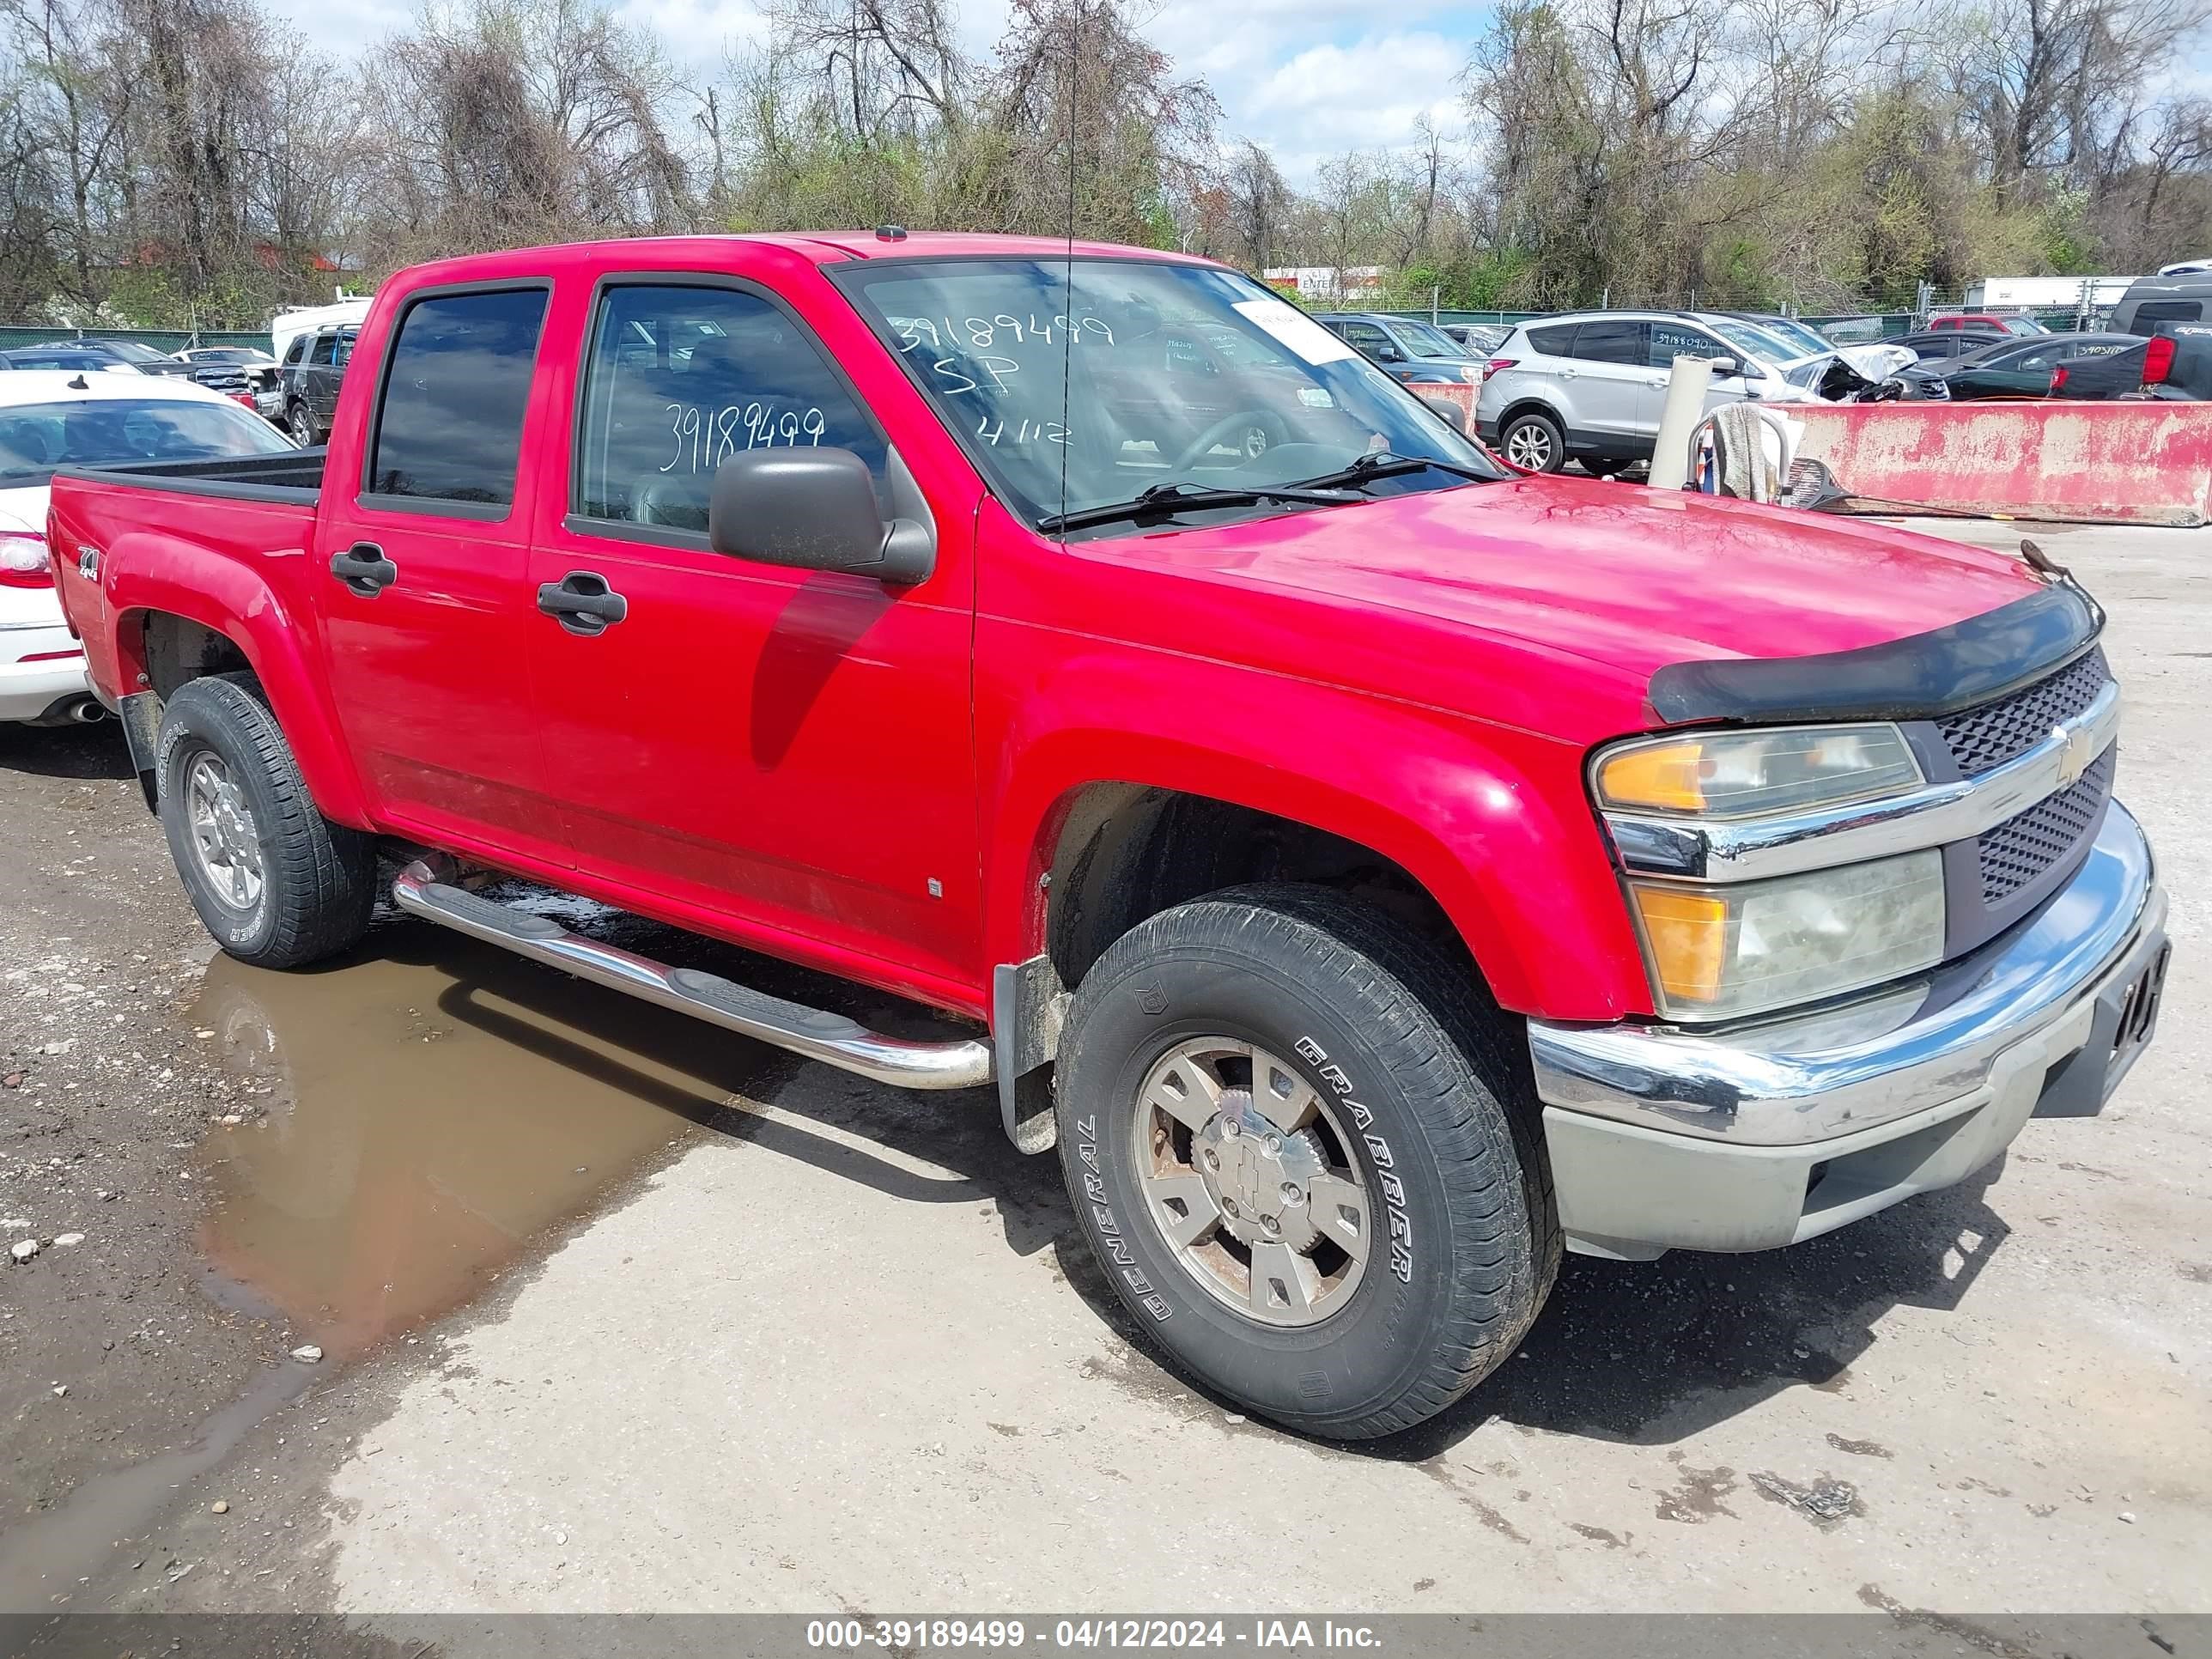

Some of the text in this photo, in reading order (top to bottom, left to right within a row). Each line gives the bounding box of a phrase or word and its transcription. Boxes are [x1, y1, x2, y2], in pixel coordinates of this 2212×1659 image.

[1656, 332, 1709, 349] 39188090
[158, 721, 190, 798] GENERAL
[1078, 1114, 1174, 1322] GENERAL
[1295, 1036, 1412, 1284] GRABBER
